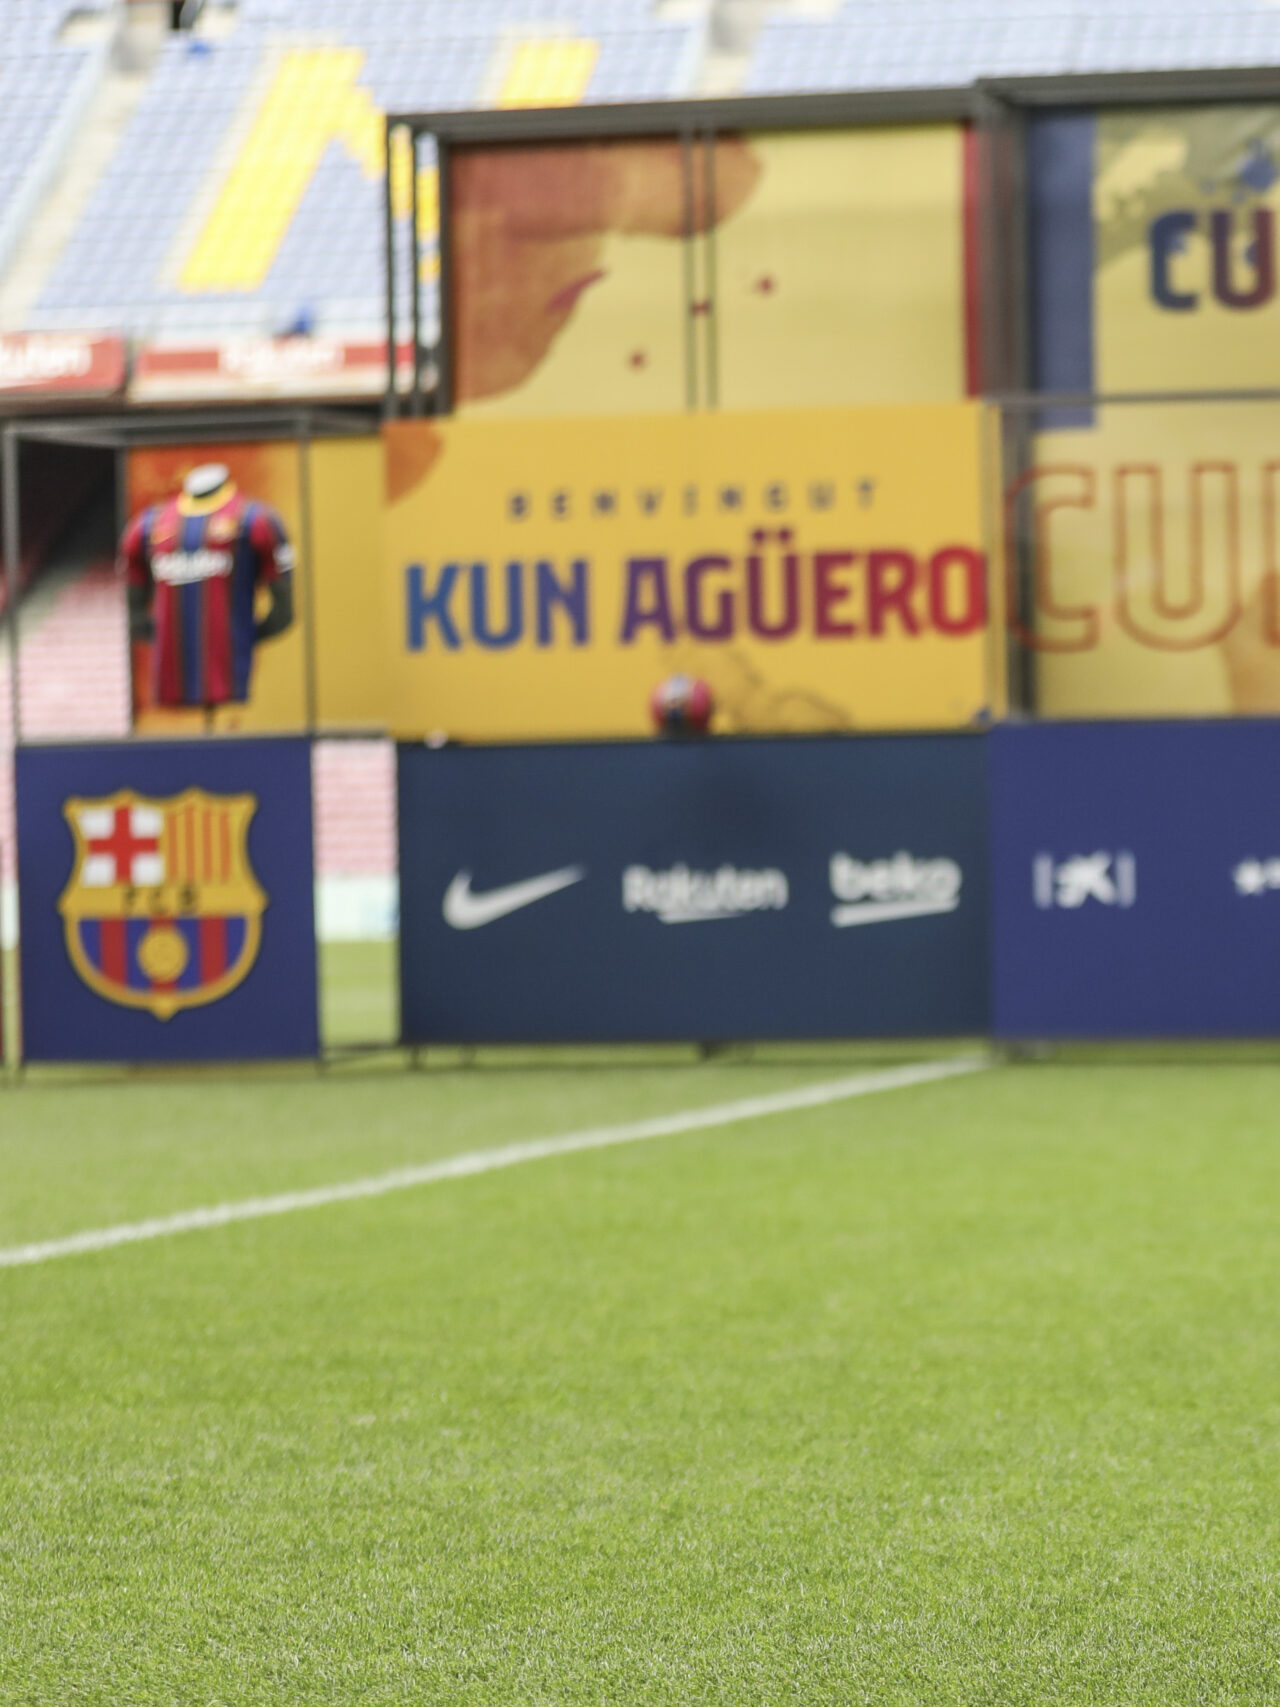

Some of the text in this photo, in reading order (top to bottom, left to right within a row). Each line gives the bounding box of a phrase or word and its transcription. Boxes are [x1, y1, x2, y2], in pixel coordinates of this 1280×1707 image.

[508, 478, 877, 521] BENVINGUT
[405, 526, 988, 653] KUN AGÜERO
[622, 864, 787, 911] Rakuten
[829, 851, 961, 900] beko
